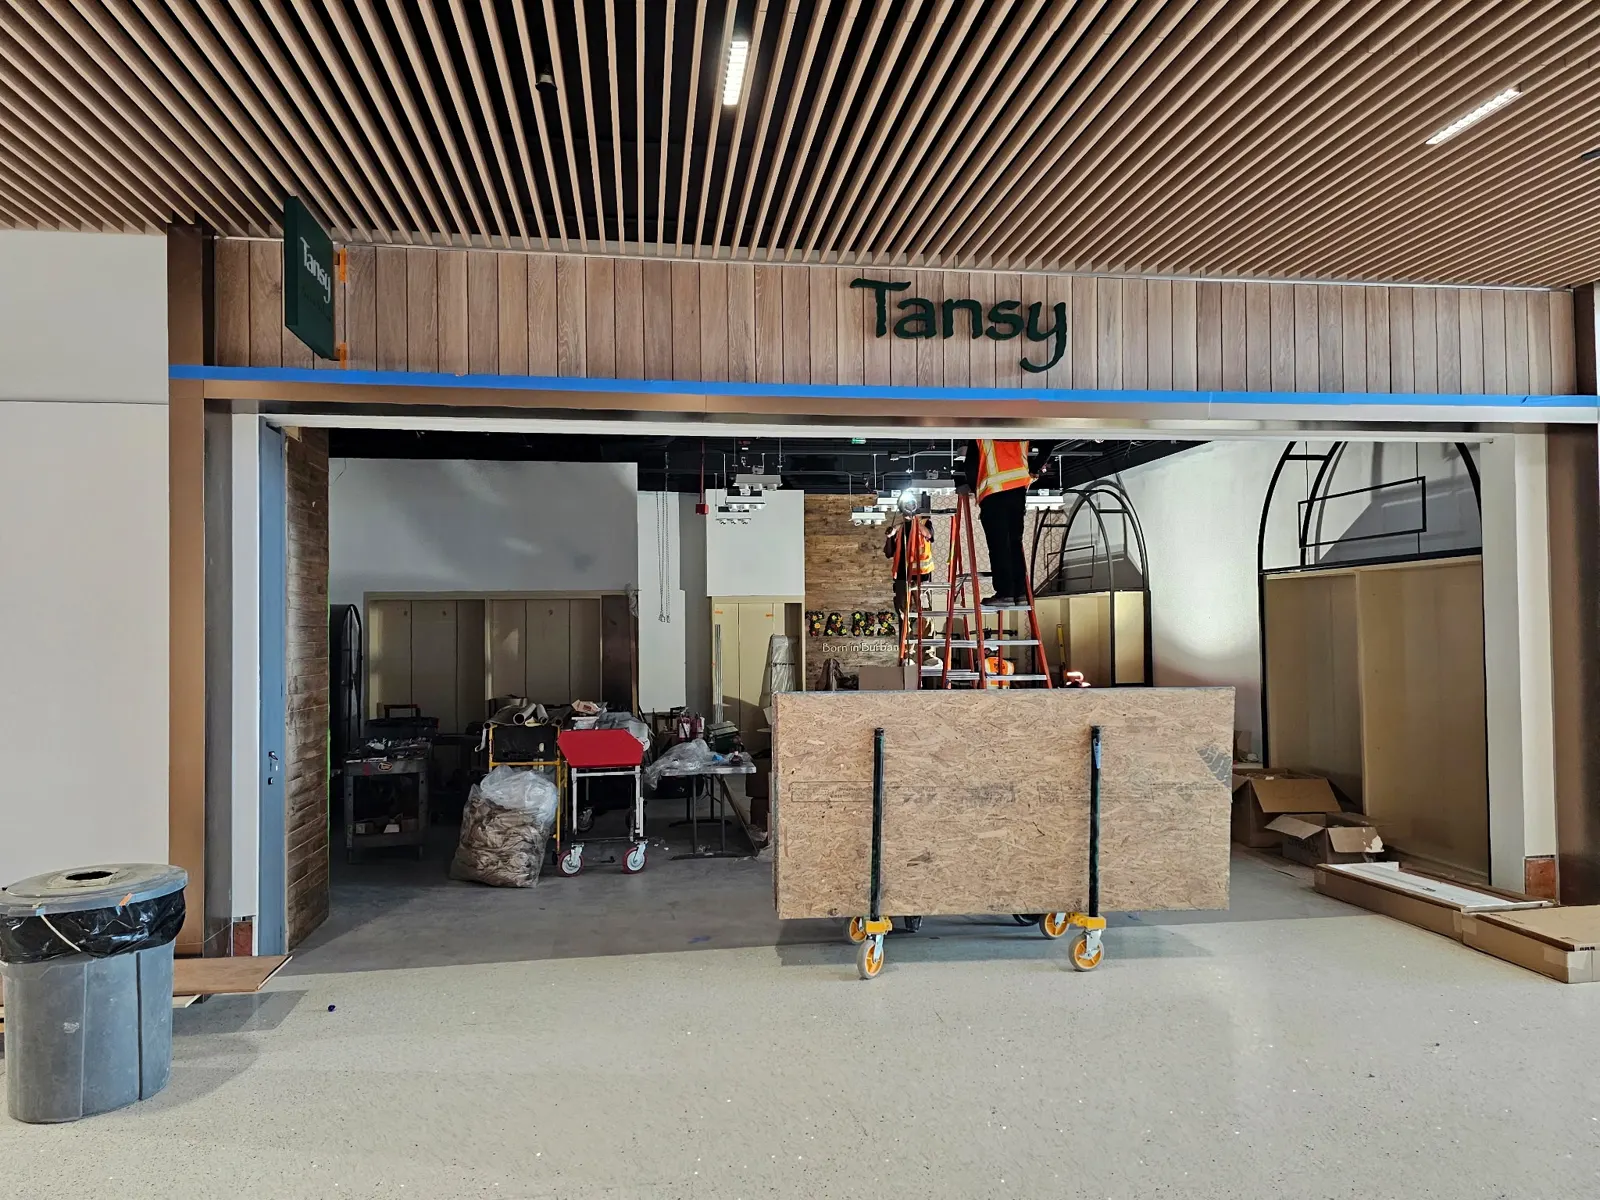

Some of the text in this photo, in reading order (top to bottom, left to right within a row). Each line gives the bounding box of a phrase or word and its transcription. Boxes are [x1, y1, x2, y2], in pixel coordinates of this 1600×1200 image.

[300, 236, 331, 304] Tansy
[850, 278, 1067, 373] Tansy
[805, 611, 897, 637] TANS
[822, 642, 900, 653] Born in Burban
